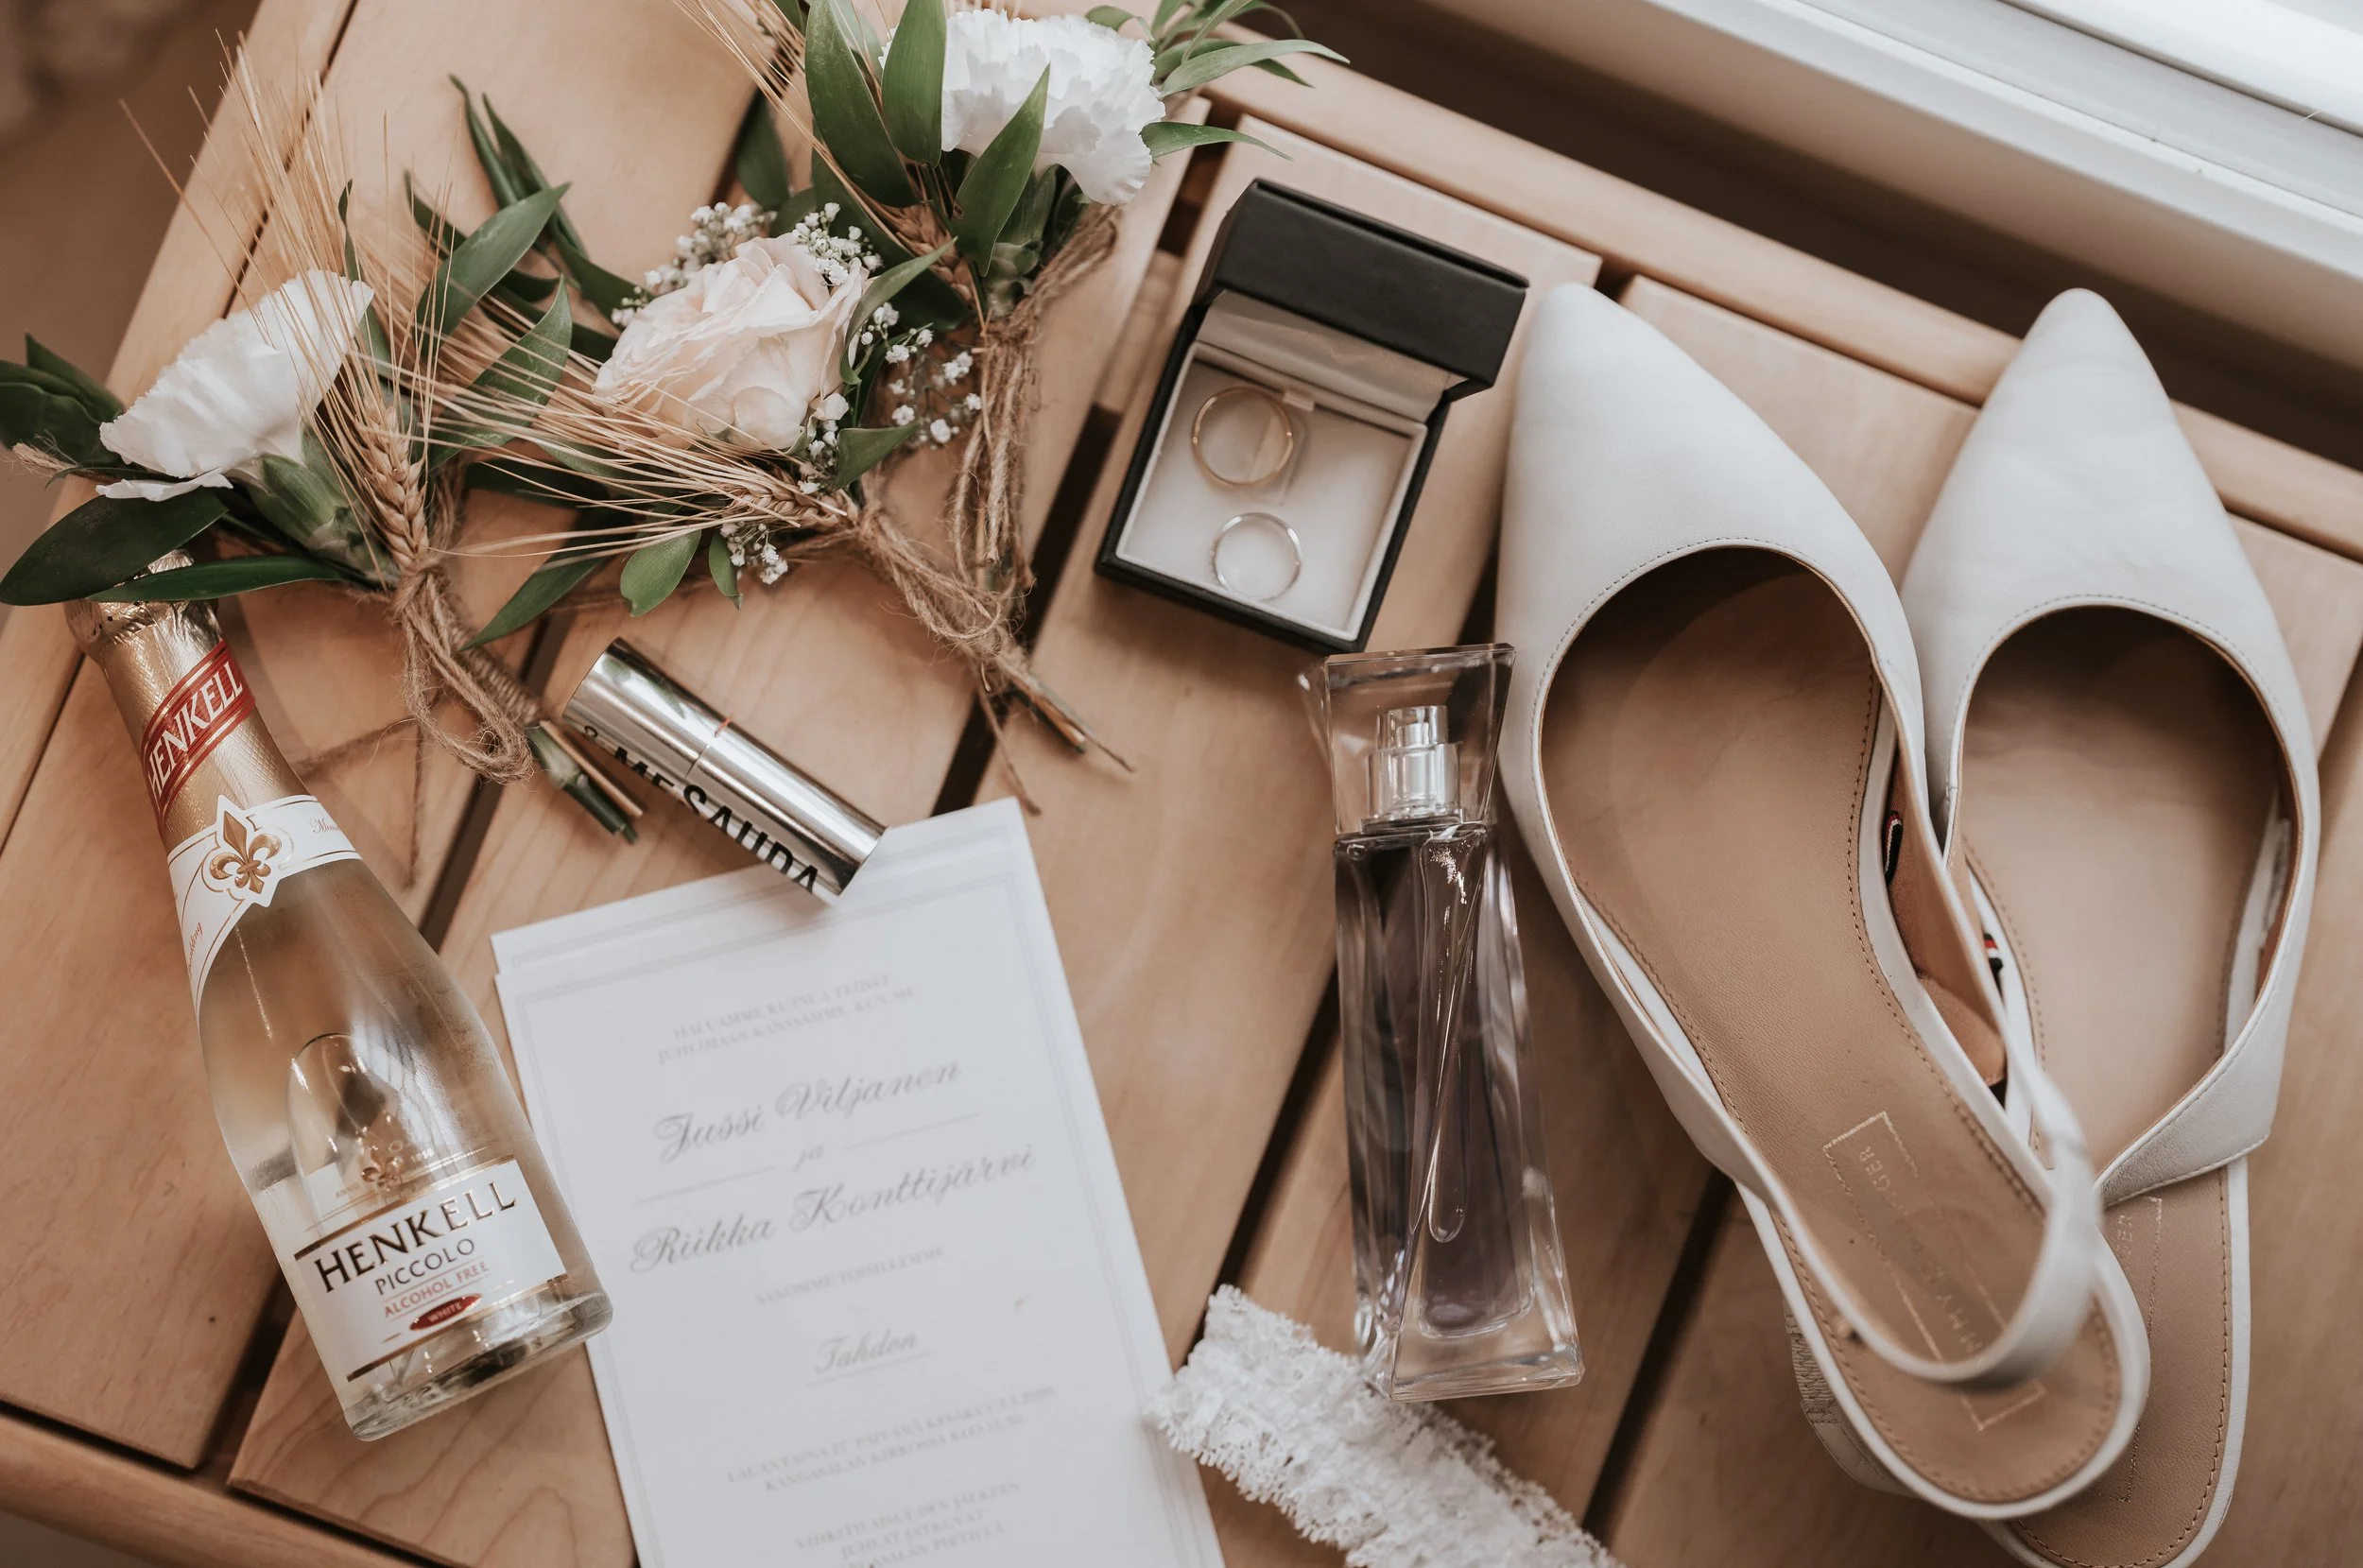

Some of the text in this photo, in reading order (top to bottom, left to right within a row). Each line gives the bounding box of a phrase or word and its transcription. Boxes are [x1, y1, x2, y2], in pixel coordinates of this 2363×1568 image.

[147, 660, 243, 804] HENKELL
[614, 746, 820, 895] SAUDA
[652, 1058, 964, 1163] Jussi Viljanen
[792, 1139, 826, 1174] ja
[313, 1180, 518, 1293] HENKELL
[630, 1143, 1037, 1274] Riikka Konttijärvi
[373, 1238, 475, 1296] PICCOLO
[384, 1261, 491, 1318] ALCOHOL FREE
[813, 1326, 920, 1374] Tahdon
